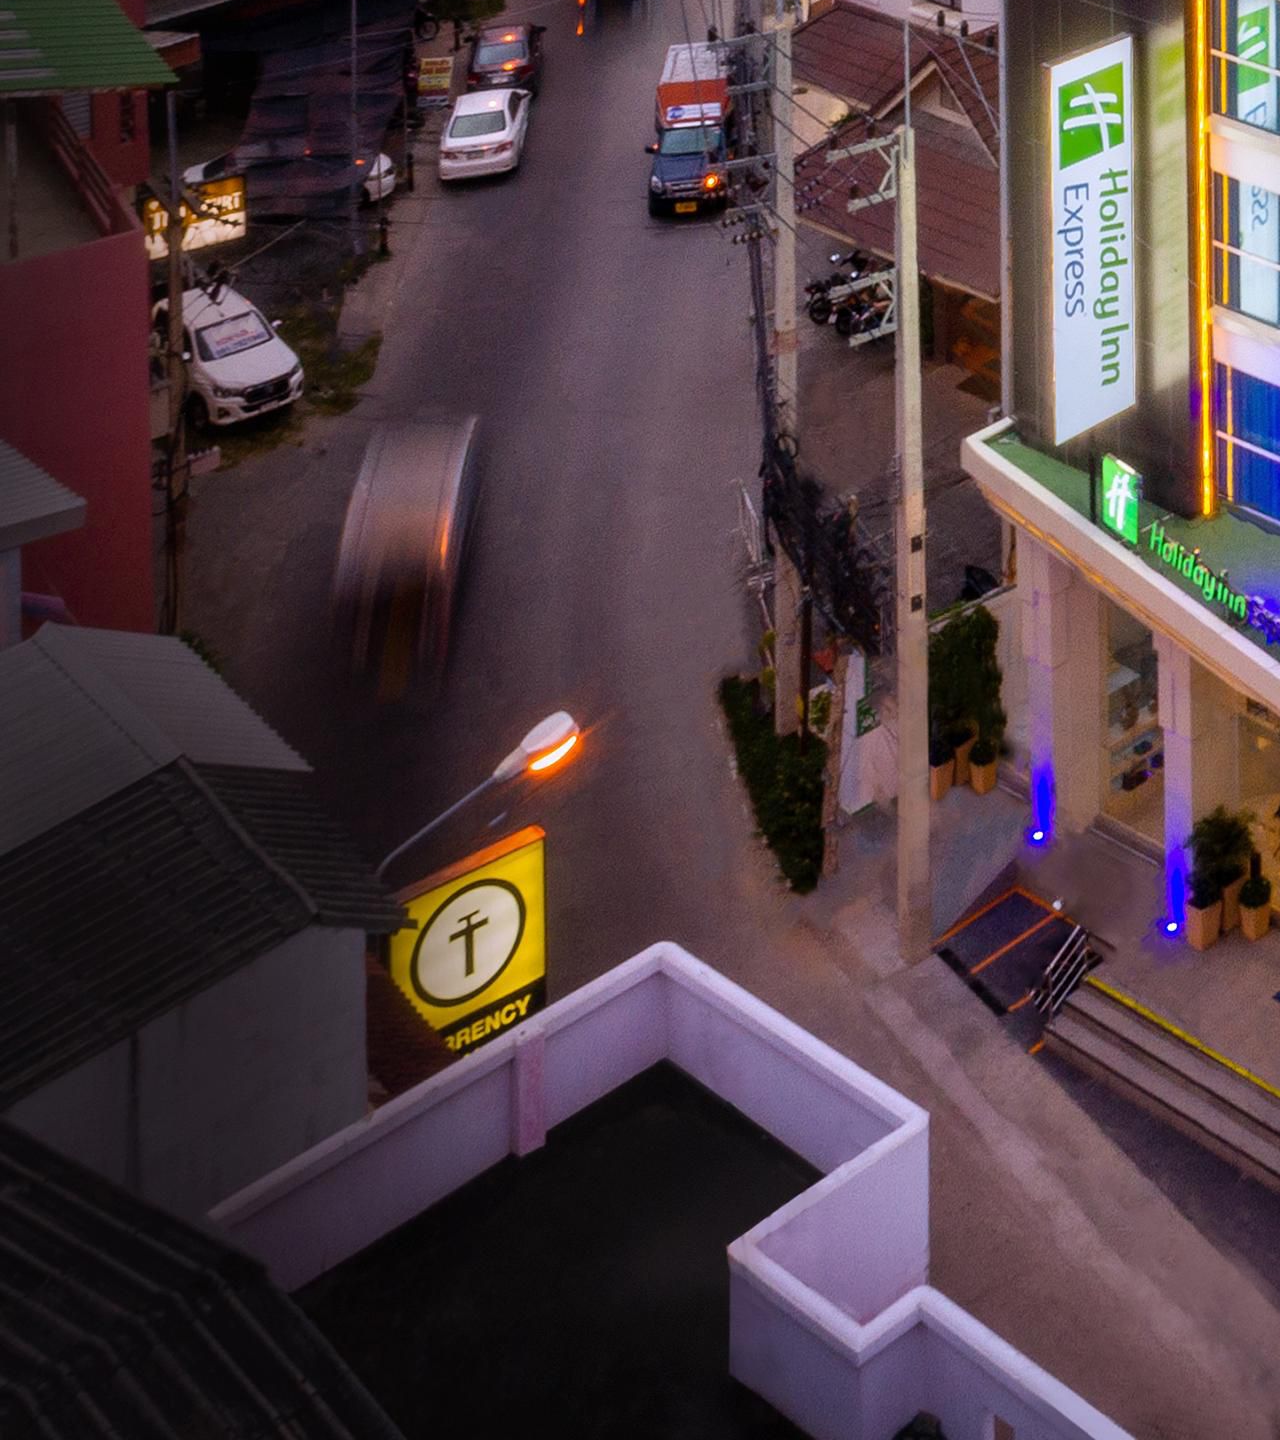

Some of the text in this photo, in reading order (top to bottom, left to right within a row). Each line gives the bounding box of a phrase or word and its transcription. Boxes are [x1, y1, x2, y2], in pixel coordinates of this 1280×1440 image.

[1057, 181, 1090, 318] Express
[1092, 168, 1130, 387] Holiday Inn
[1148, 520, 1217, 602] Holiday
